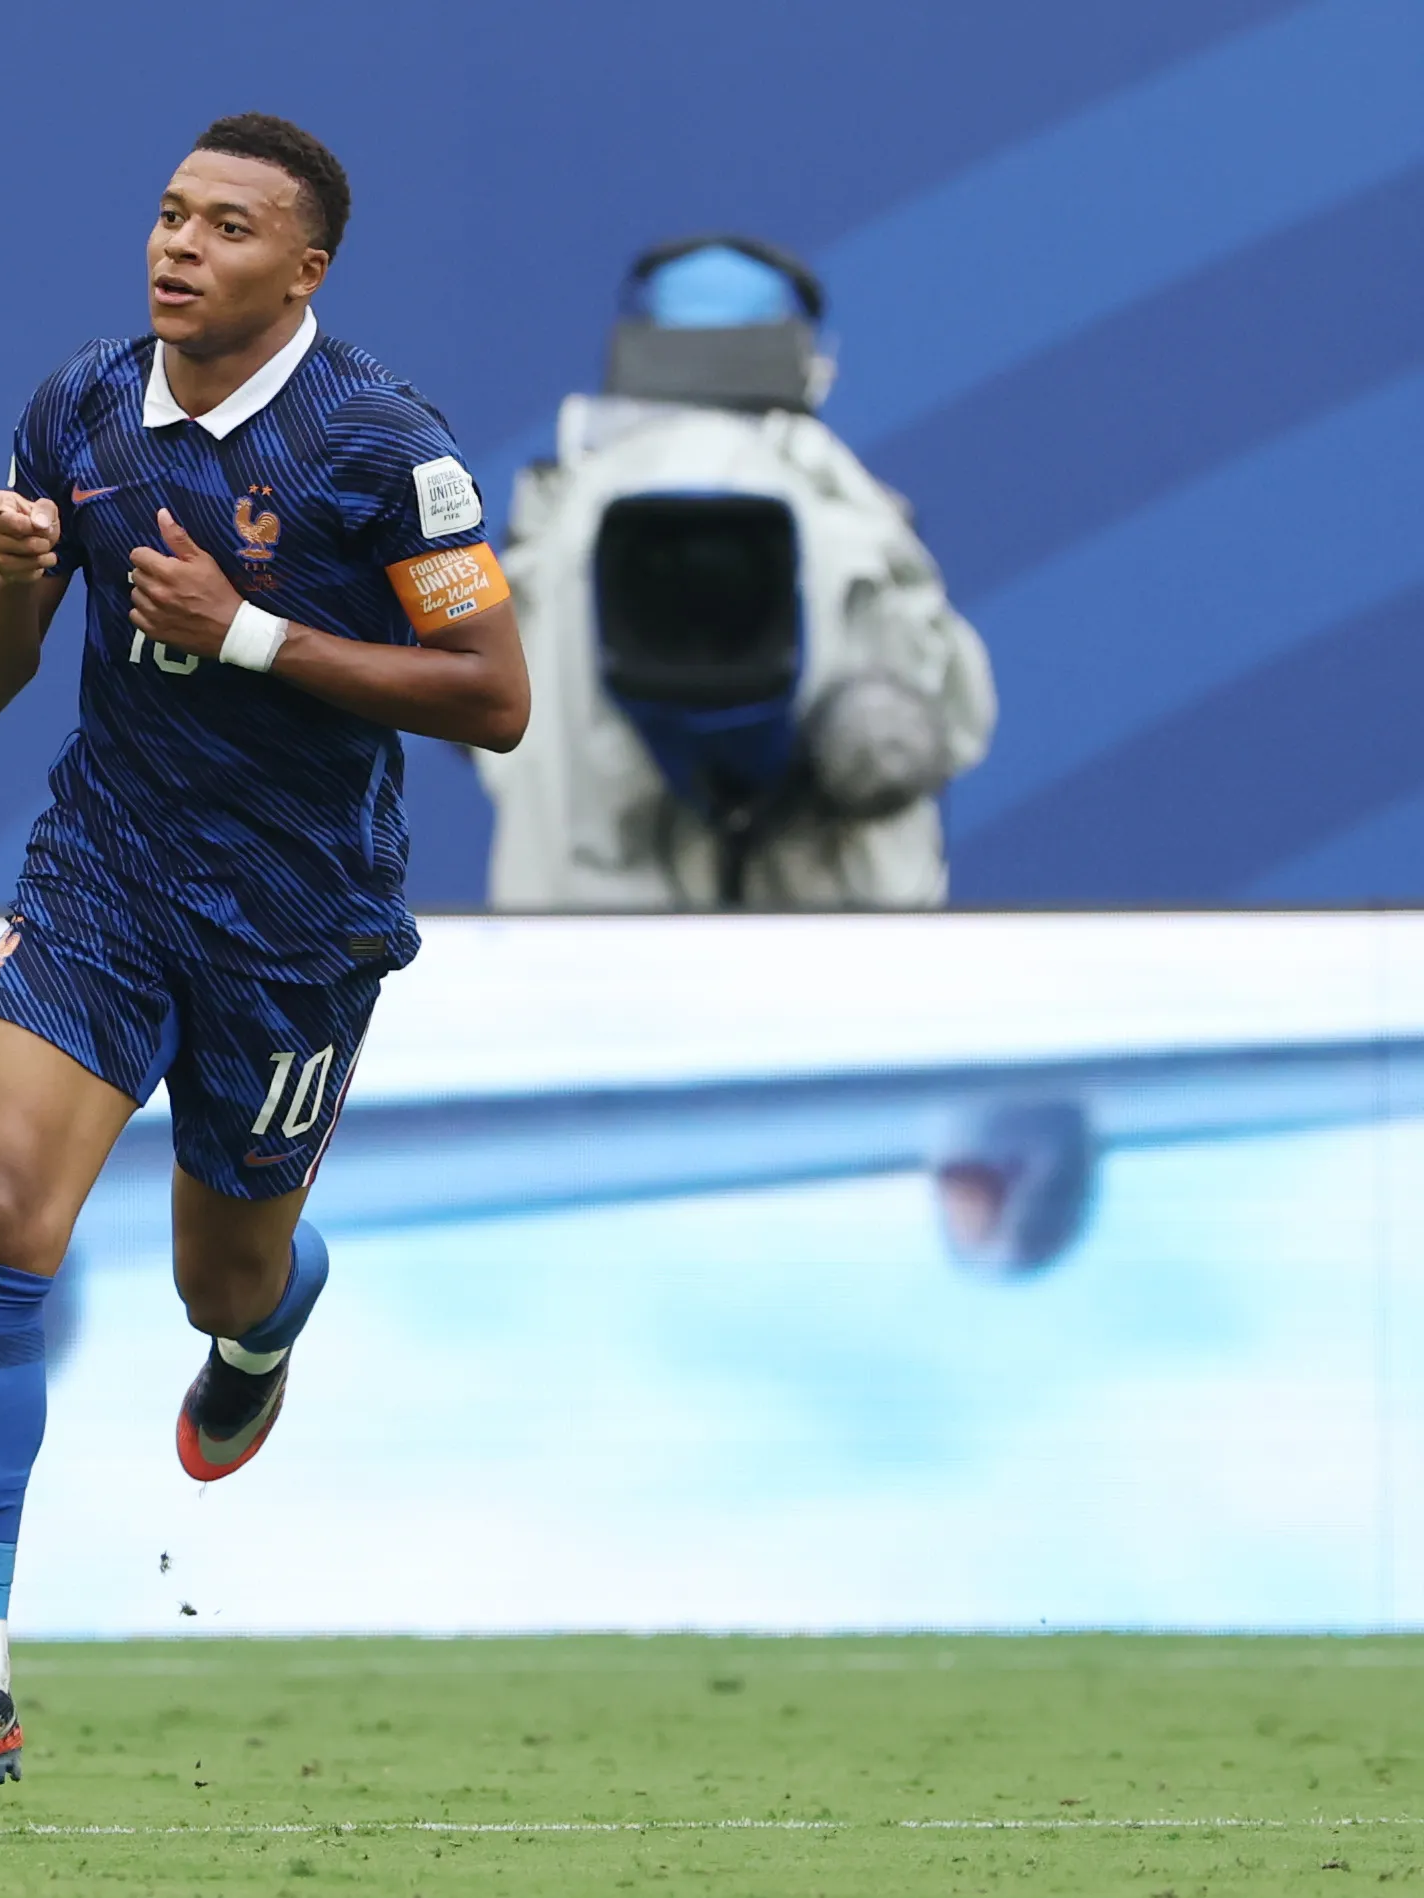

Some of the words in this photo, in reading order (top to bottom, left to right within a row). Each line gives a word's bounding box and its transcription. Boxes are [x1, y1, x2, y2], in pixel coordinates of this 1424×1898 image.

[427, 468, 462, 487] FOOTBALL
[429, 480, 466, 502] UNITES
[428, 502, 444, 516] the
[443, 513, 461, 521] FIFA
[408, 547, 470, 578] FOOTBALL
[414, 556, 480, 595] UNITES
[420, 595, 446, 613] the
[445, 571, 490, 603] World
[448, 601, 474, 617] FIFA
[250, 1043, 334, 1138] 10
